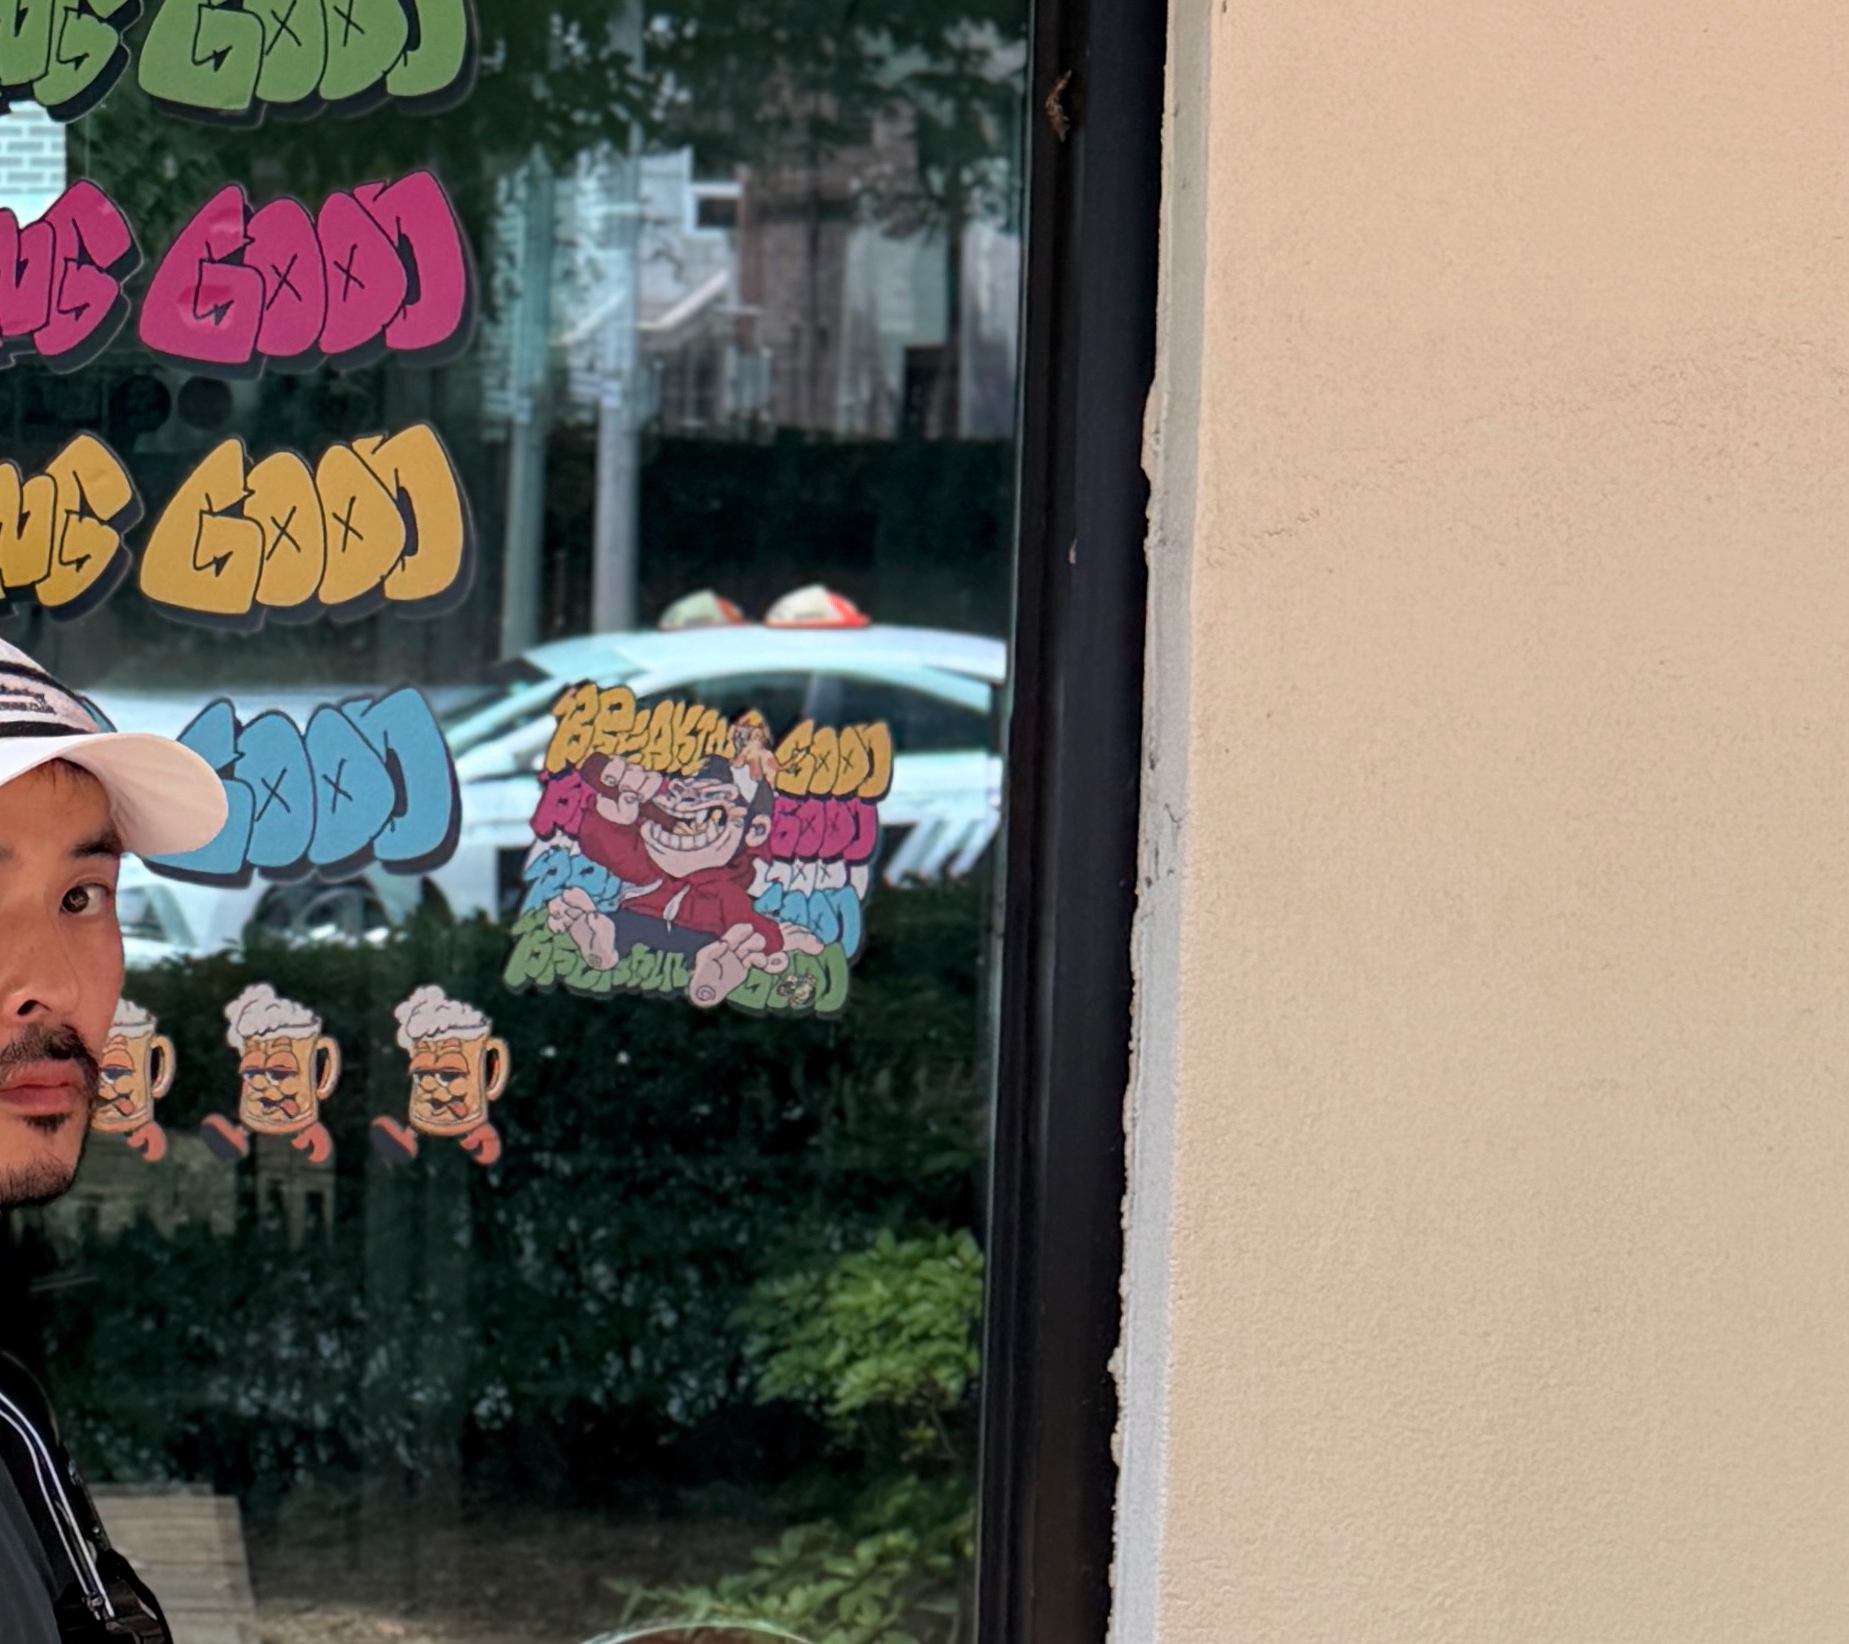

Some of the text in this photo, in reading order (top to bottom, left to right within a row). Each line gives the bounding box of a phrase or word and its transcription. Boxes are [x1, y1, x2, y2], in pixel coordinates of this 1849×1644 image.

[137, 170, 476, 378] GOOD
[137, 423, 476, 629] GOOD
[546, 679, 736, 777] BREAKIN
